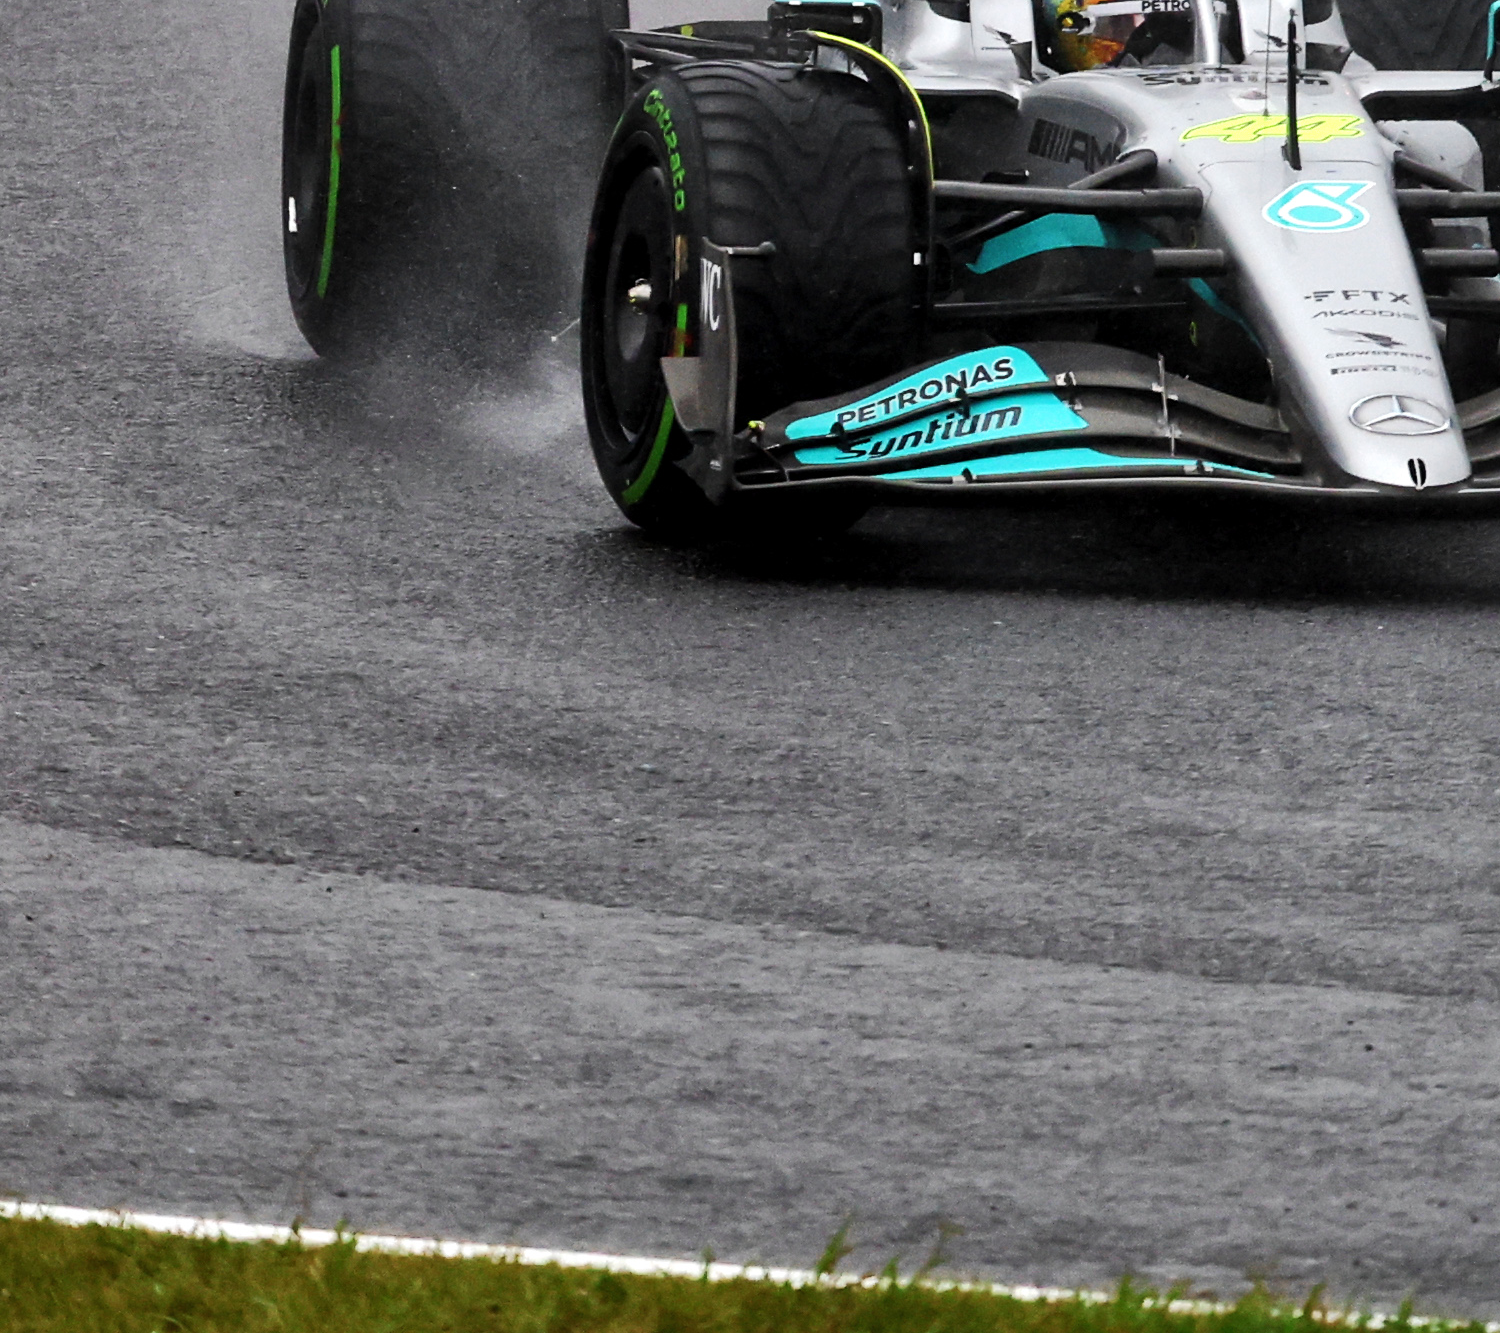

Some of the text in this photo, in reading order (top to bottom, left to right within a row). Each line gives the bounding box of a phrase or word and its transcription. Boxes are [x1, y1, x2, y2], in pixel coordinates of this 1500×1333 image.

[1181, 114, 1364, 142] 44
[1341, 289, 1410, 306] FTX
[838, 356, 1015, 428] PETRONAS
[834, 404, 1023, 463] Syntium
